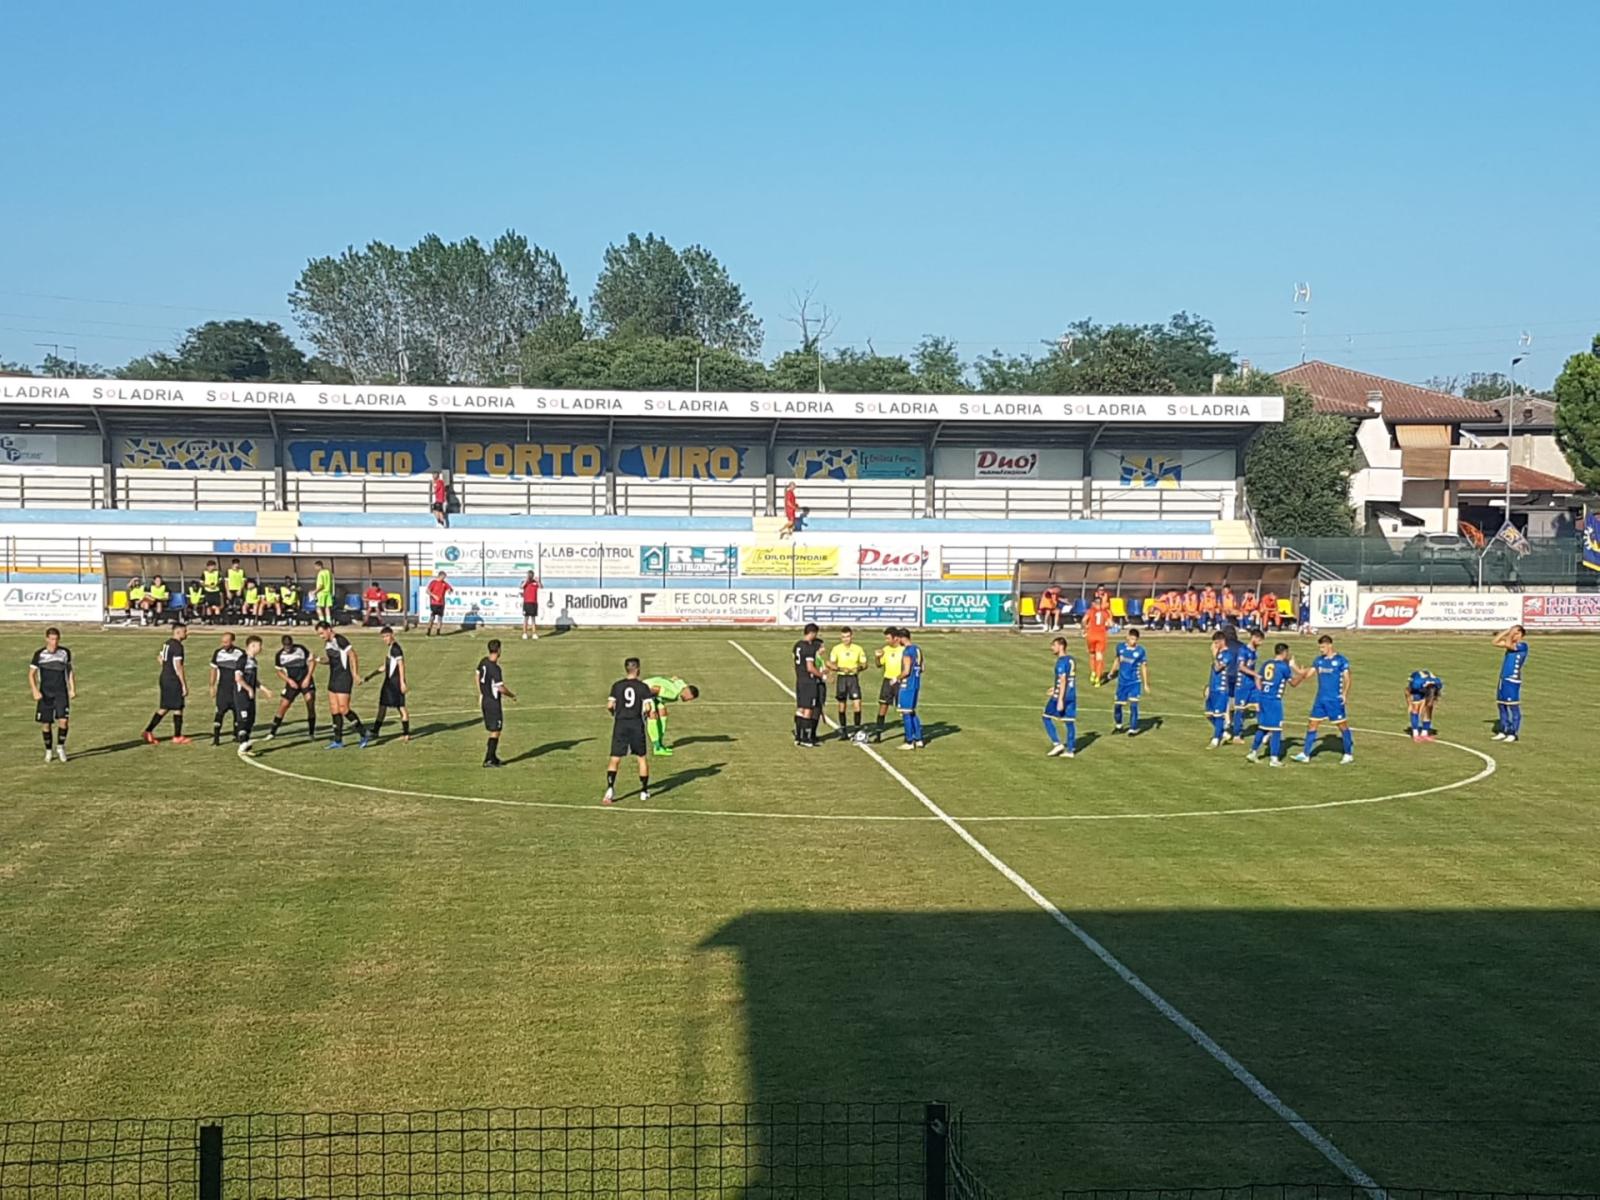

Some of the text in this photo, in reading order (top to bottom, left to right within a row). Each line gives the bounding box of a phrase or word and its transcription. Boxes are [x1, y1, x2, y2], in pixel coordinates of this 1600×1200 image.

[0, 386, 1251, 417] LADRIA SOLADRIA SOLADRIA SOLADRIA SOLADRIA SOLADRIA SOLADRIA SOLADRIA SOLADRIA SOLADRIA SOLADRIA SOLADRIA
[309, 443, 739, 481] CALCIO PORTO VIRO
[977, 450, 1030, 468] Duo
[470, 549, 534, 559] GEOVENTIS
[552, 547, 635, 558] LAB-CONTROL
[565, 594, 628, 609] RadioDiva
[674, 592, 775, 606] FE COLOR SRLS
[784, 593, 907, 607] FCM Group srl
[1372, 604, 1415, 618] Delta
[1264, 663, 1275, 681] 6
[624, 687, 636, 708] 9
